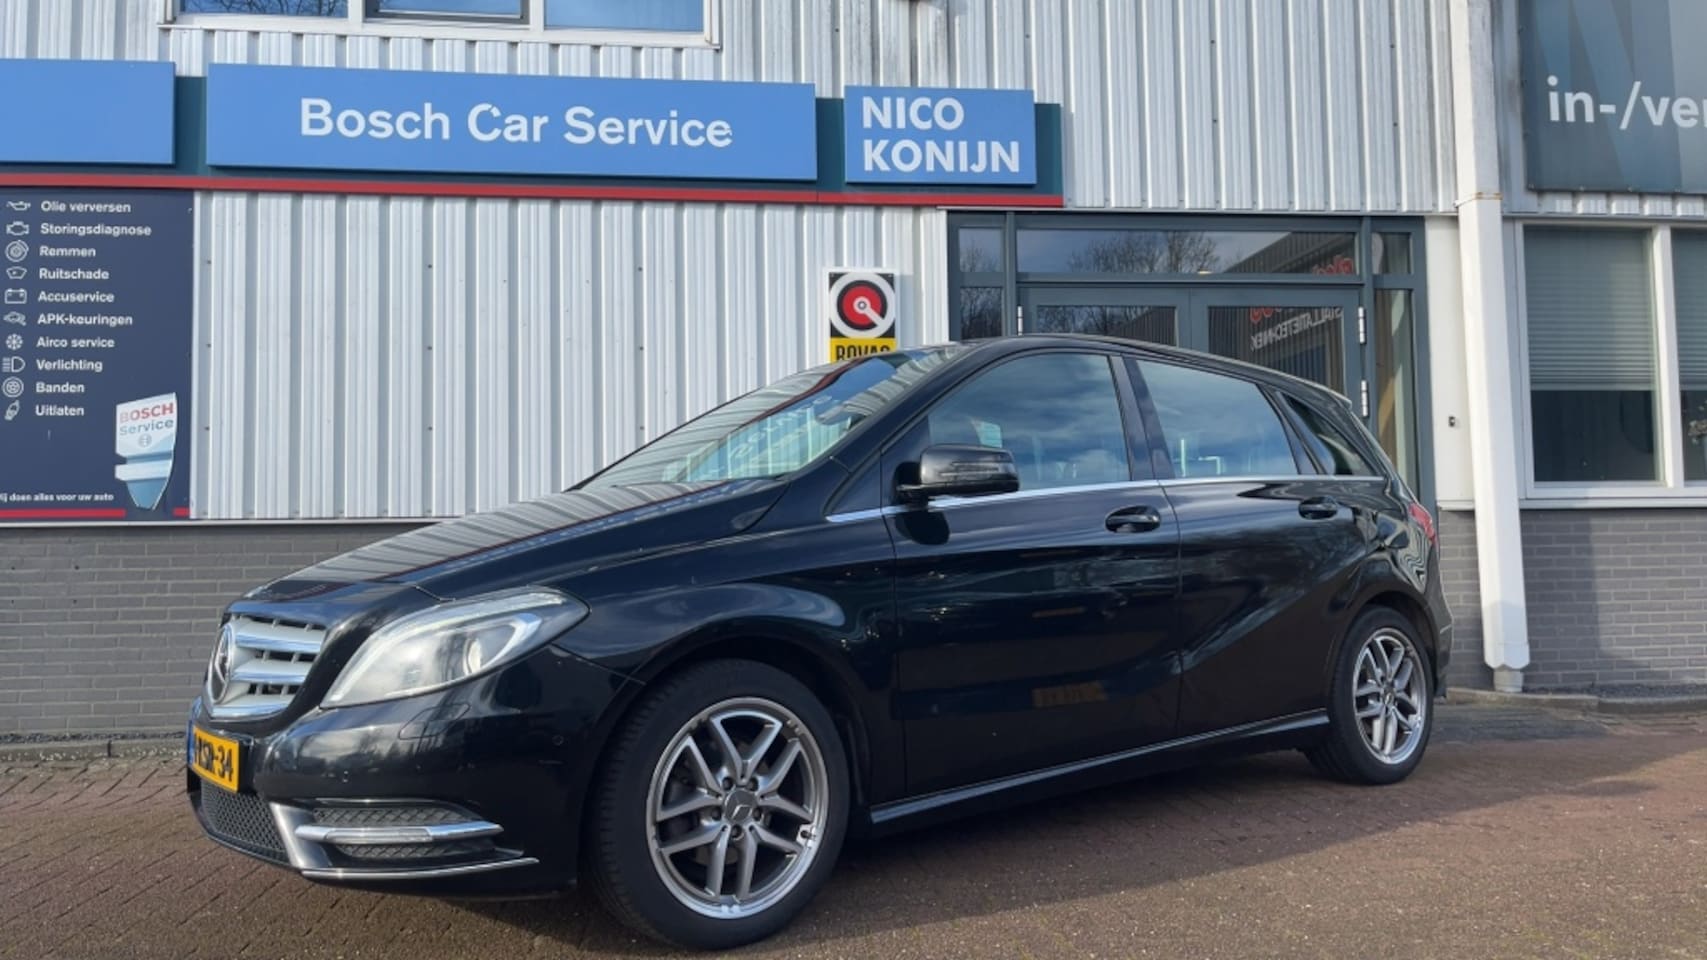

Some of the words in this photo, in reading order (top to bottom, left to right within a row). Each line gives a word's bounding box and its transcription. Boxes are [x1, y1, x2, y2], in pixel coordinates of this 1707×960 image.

[1547, 75, 1707, 130] in-/ve
[861, 96, 965, 131] NICO
[300, 98, 450, 142] Bosch
[467, 103, 548, 143] Car
[564, 106, 733, 149] Service
[861, 138, 1020, 175] KONIJN
[41, 200, 66, 212] Olie
[70, 202, 131, 213] verversen
[40, 223, 152, 237] Storingsdiagnose
[40, 246, 96, 257] Remmen
[39, 268, 109, 280] Ruitschade
[38, 290, 115, 303] Accuservice
[37, 314, 133, 327] APK-keuringen
[36, 336, 68, 348] Airco
[71, 337, 115, 348] service
[36, 359, 103, 373] Verlichting
[35, 382, 85, 393] Banden
[35, 405, 84, 417] Uitlaten
[119, 402, 174, 424] BOSCH
[119, 418, 174, 436] Service
[34, 493, 54, 501] alles
[93, 493, 114, 501] auto
